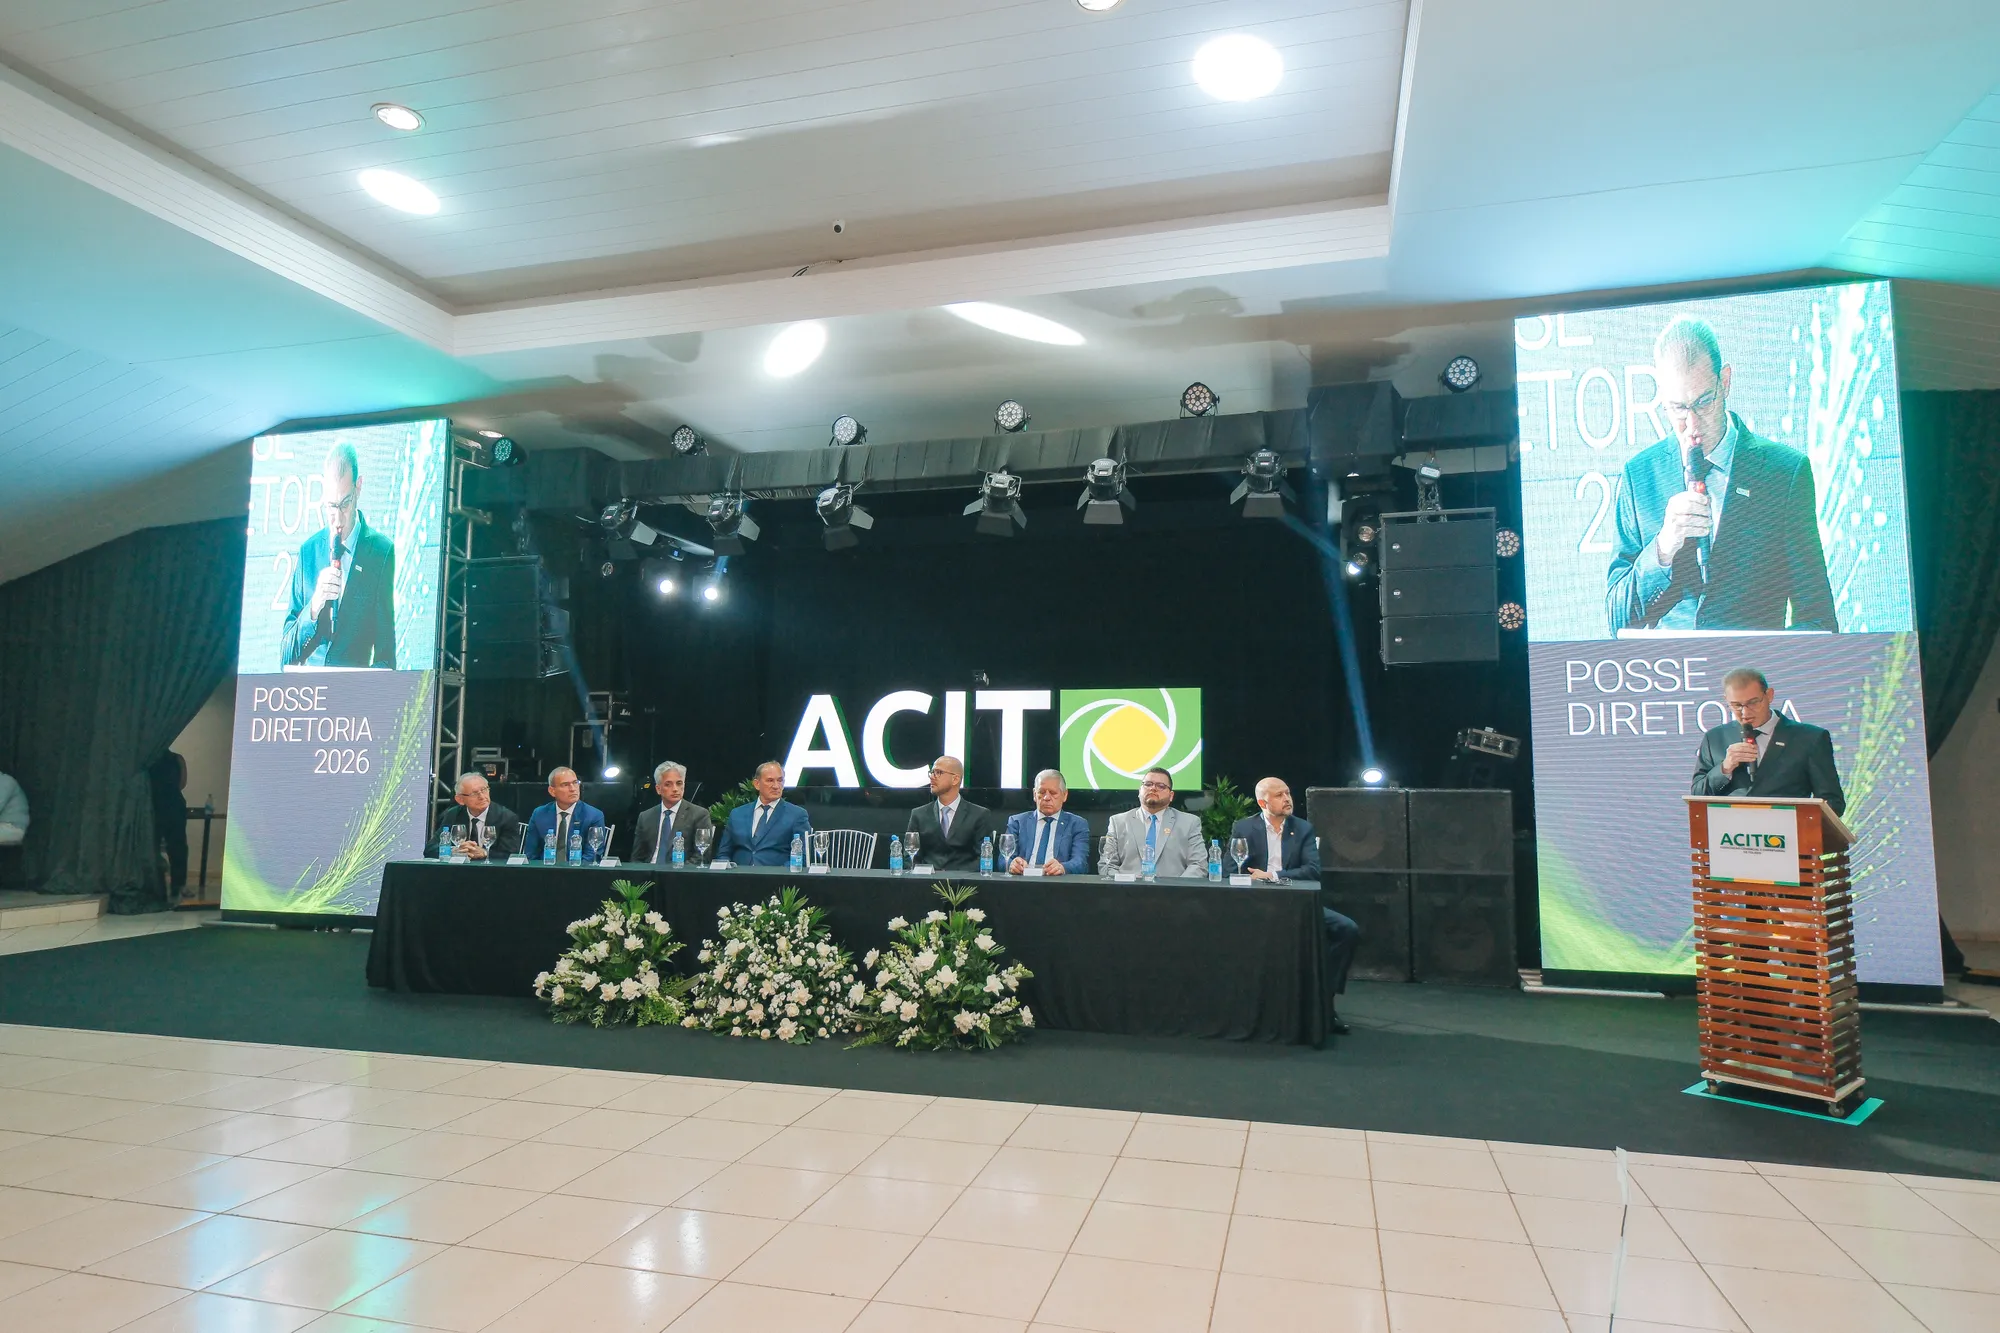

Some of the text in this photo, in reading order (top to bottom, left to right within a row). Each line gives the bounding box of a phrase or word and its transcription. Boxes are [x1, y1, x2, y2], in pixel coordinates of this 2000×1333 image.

[1565, 657, 1709, 693] POSSE
[253, 686, 329, 712] POSSE
[251, 716, 373, 742] DIRETORIA
[1567, 699, 1802, 736] DIRETOA
[783, 689, 1052, 789] ACIT
[314, 748, 370, 774] 2026
[1720, 833, 1762, 847] ACIT
